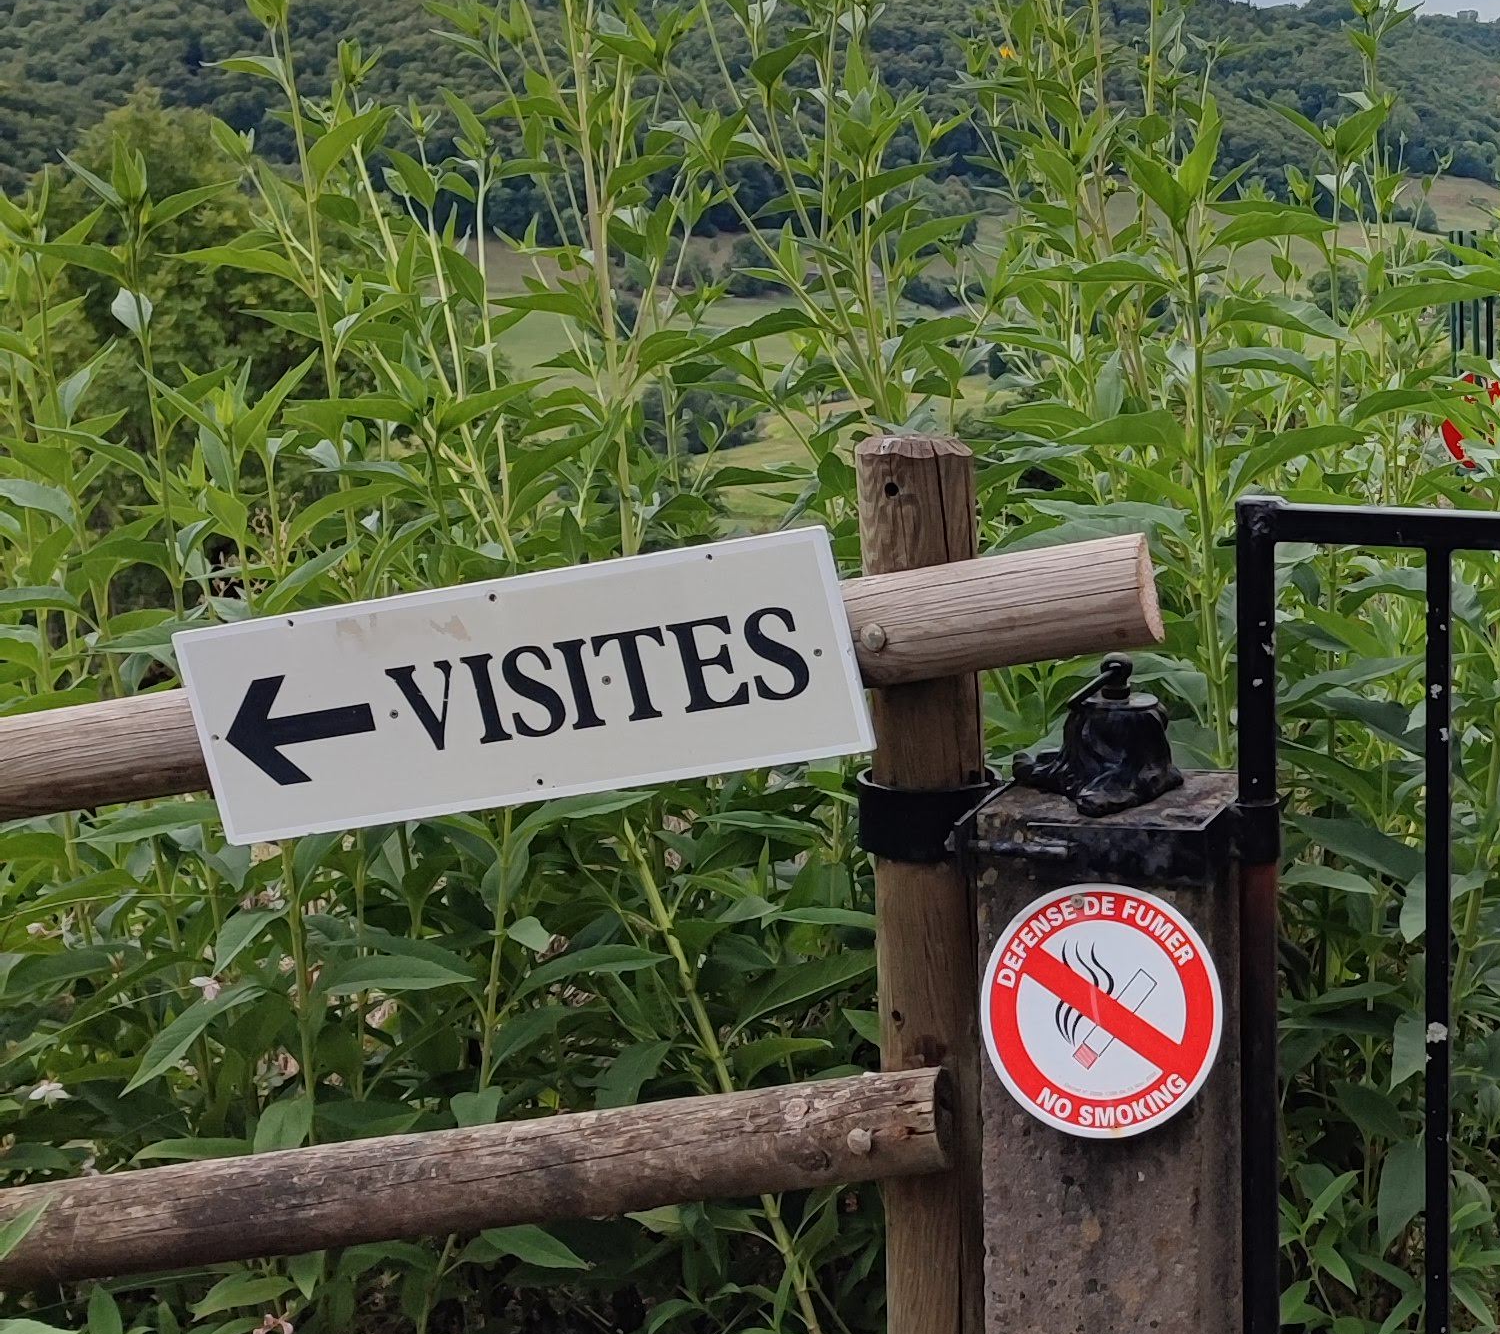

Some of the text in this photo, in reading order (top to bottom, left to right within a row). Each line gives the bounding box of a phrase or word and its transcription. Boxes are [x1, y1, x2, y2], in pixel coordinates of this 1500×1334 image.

[384, 606, 810, 751] VISITES
[997, 896, 1195, 988] DEFENSE DE FUMER
[1036, 1087, 1073, 1119] NO
[1078, 1073, 1188, 1127] SMOKING
